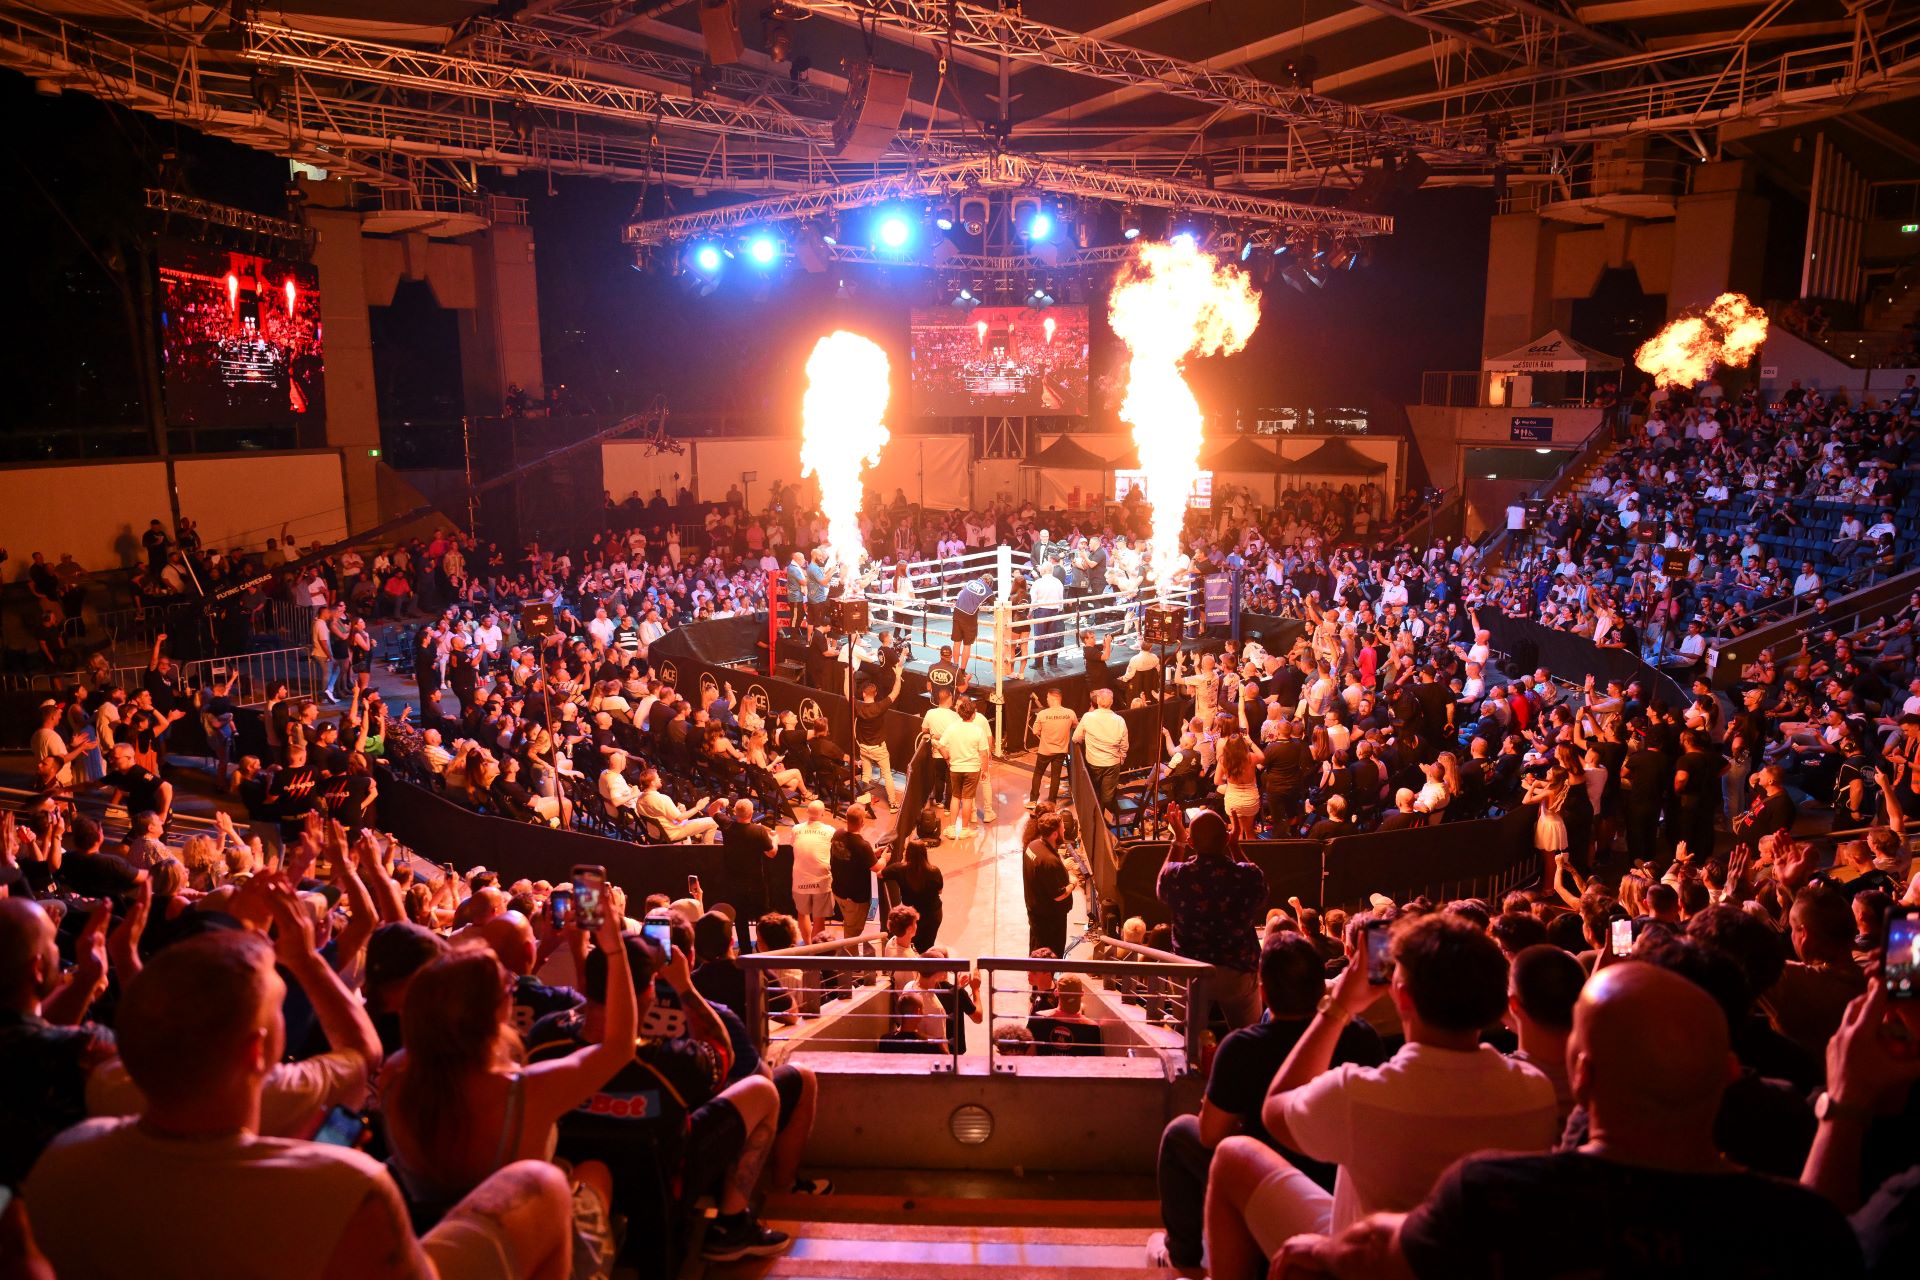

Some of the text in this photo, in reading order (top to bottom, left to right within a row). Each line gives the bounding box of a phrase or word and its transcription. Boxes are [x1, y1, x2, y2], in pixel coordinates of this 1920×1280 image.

[1527, 340, 1562, 353] eat
[215, 573, 273, 601] FLYING CAMERAS
[662, 668, 676, 681] ACE
[933, 671, 949, 681] FOX
